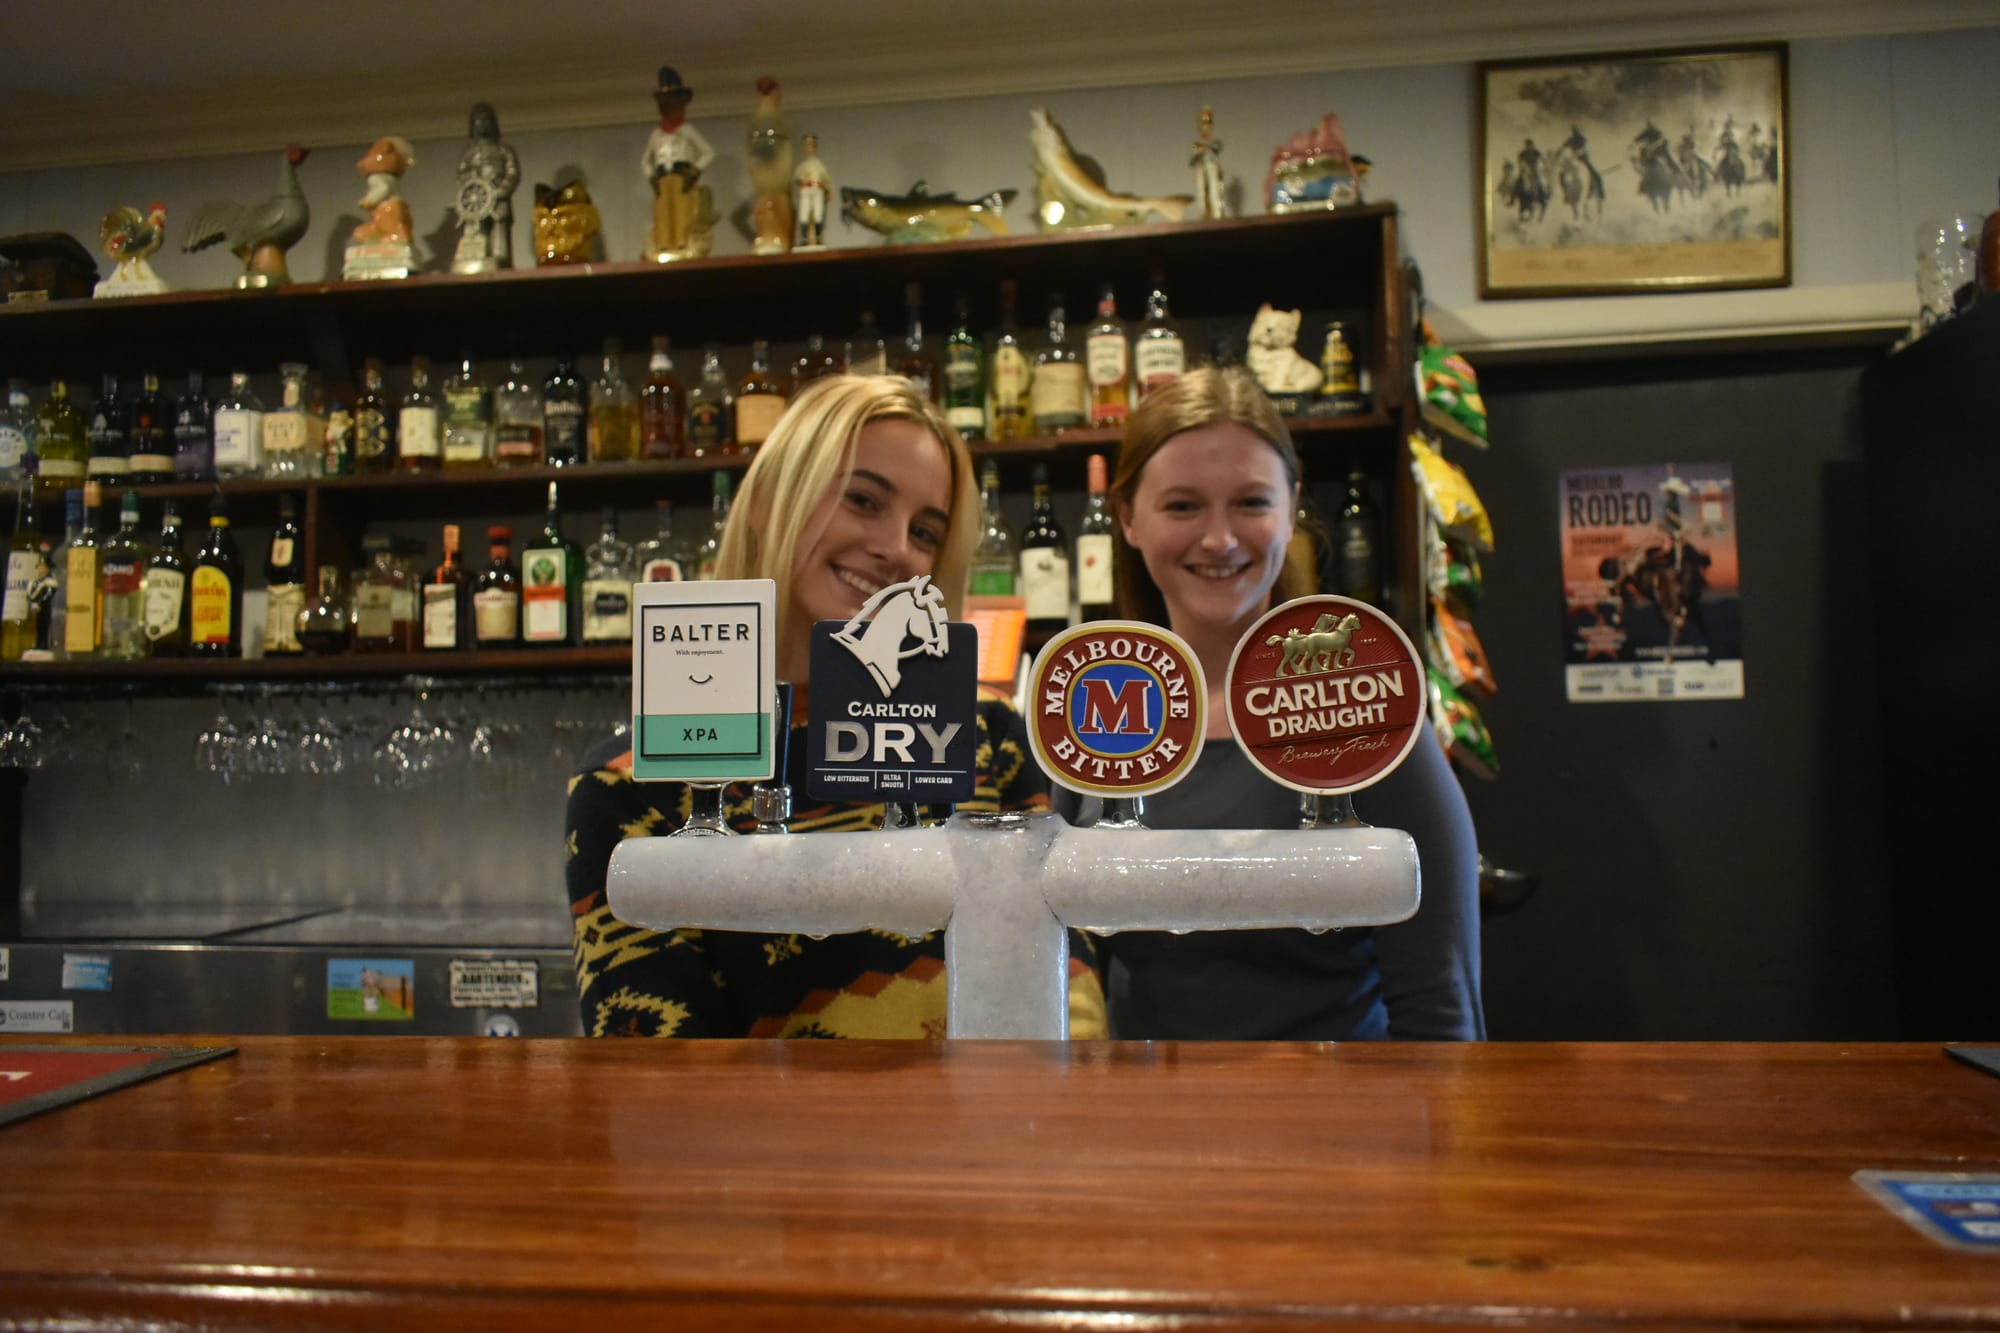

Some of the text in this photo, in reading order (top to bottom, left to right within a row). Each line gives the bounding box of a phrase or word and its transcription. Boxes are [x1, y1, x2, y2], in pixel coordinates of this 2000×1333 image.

[1568, 492, 1652, 528] RODEO
[652, 623, 750, 642] BALTER
[1045, 638, 1190, 719] MELBOURNE
[1244, 670, 1406, 717] CARLTON
[847, 701, 937, 718] CARLTON
[1078, 679, 1154, 735] M
[1267, 702, 1390, 739] DRAUGHT
[682, 728, 718, 741] XPA
[823, 720, 963, 764] DRY
[1277, 733, 1391, 766] Brewery Fresh
[1051, 735, 1183, 780] BITTER
[838, 776, 870, 784] BITTERNESS
[882, 774, 902, 782] ULTRA
[915, 776, 935, 784] LOWER
